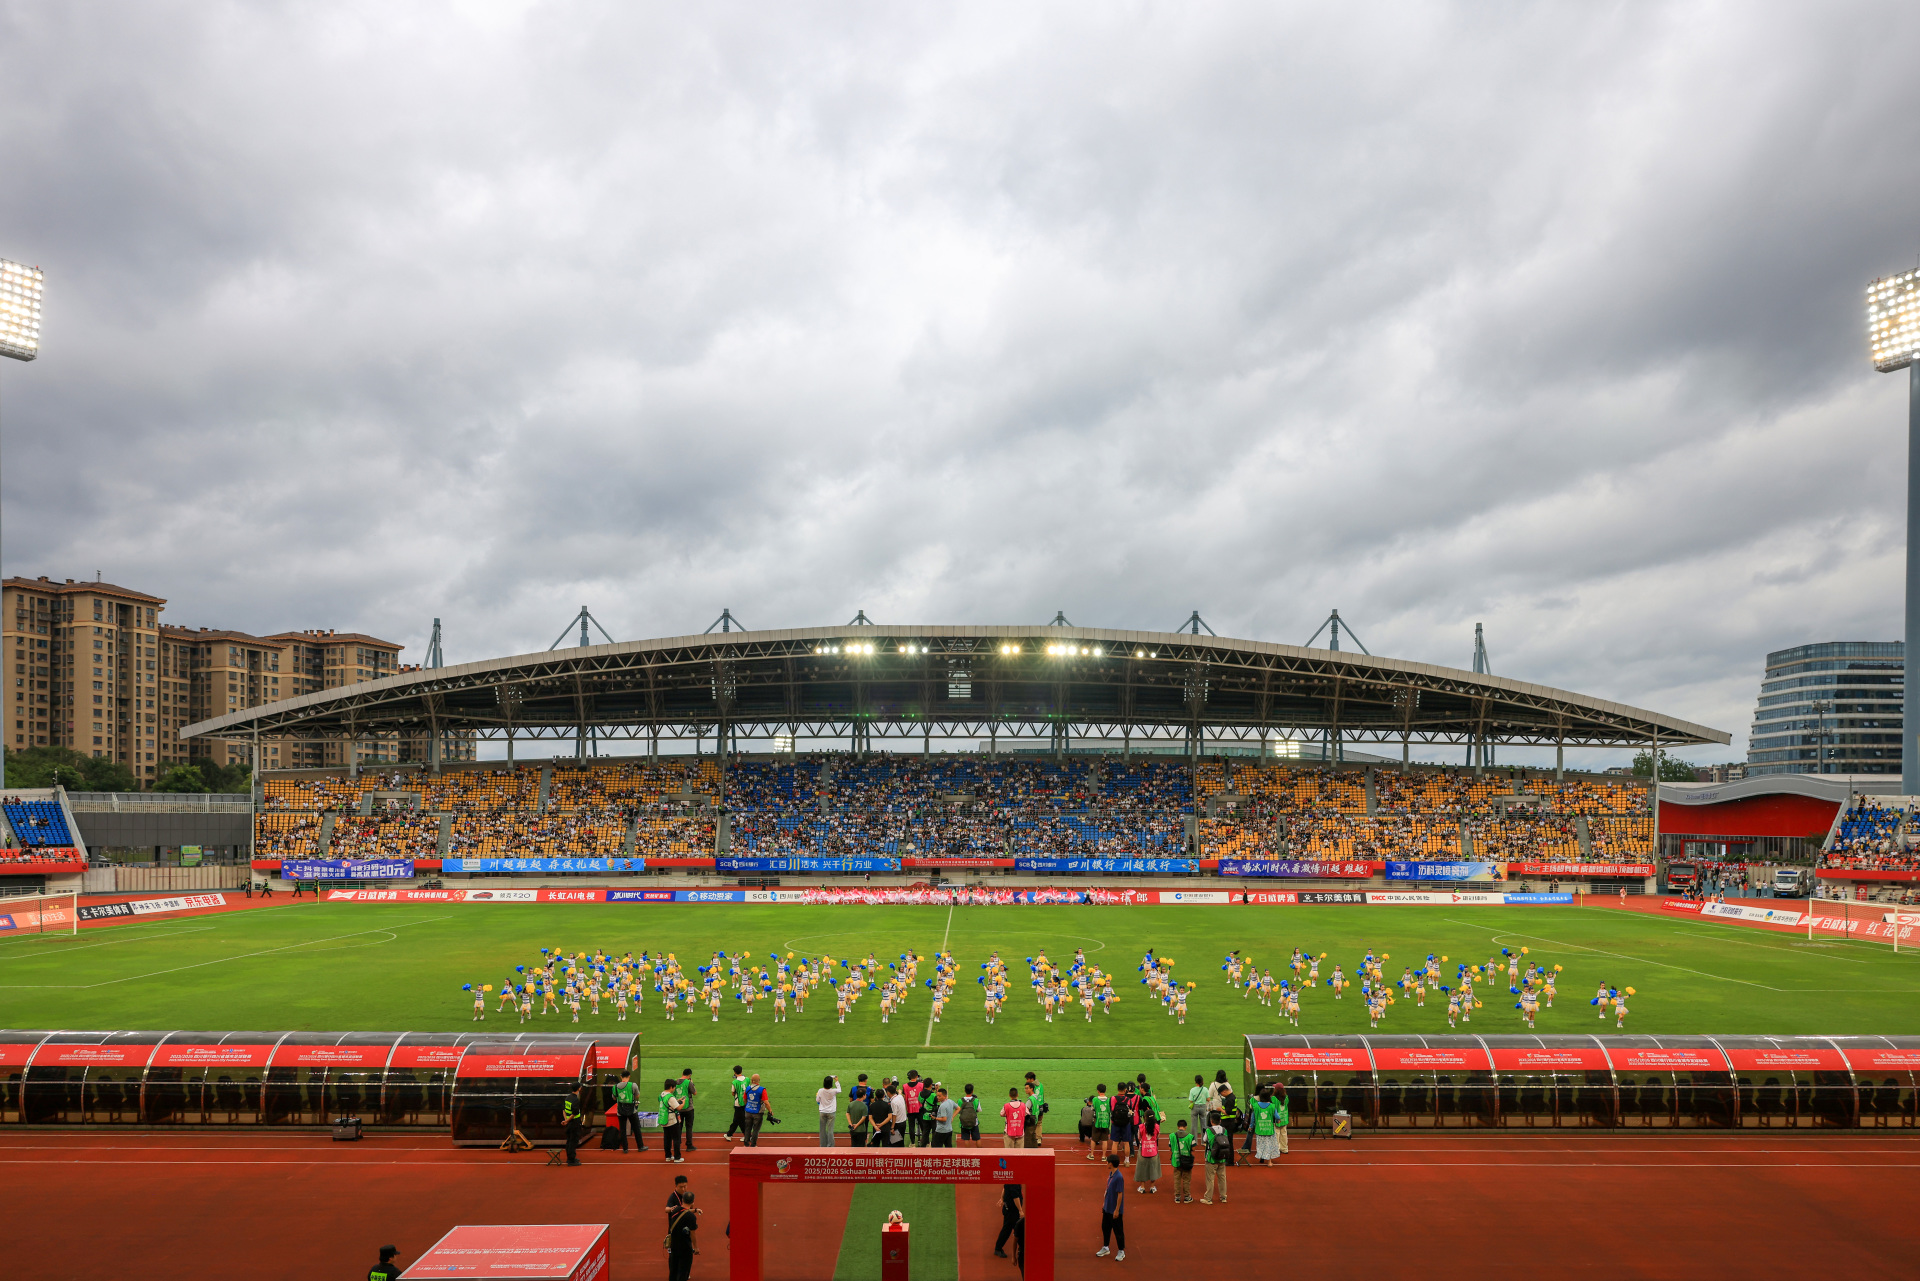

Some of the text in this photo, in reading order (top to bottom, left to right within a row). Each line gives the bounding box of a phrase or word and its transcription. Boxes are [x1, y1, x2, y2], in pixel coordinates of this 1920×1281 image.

[490, 859, 542, 870] 川超雄起
[769, 858, 872, 870] 汇百川活水 兴千行万业
[1242, 863, 1290, 874] 喝冰川时代
[380, 864, 405, 876] 20元
[184, 894, 220, 907] 京东电器
[548, 892, 595, 900] 长虹AI电视
[1259, 894, 1295, 902] 百威啤酒
[1315, 894, 1362, 902] 卡尔美体育
[90, 905, 130, 917] 卡尔美体育
[1822, 918, 1859, 931] 百威啤酒
[1866, 922, 1913, 939] 红花郎
[804, 1158, 980, 1168] 2025/2026 四川银行四川省城市足球联赛
